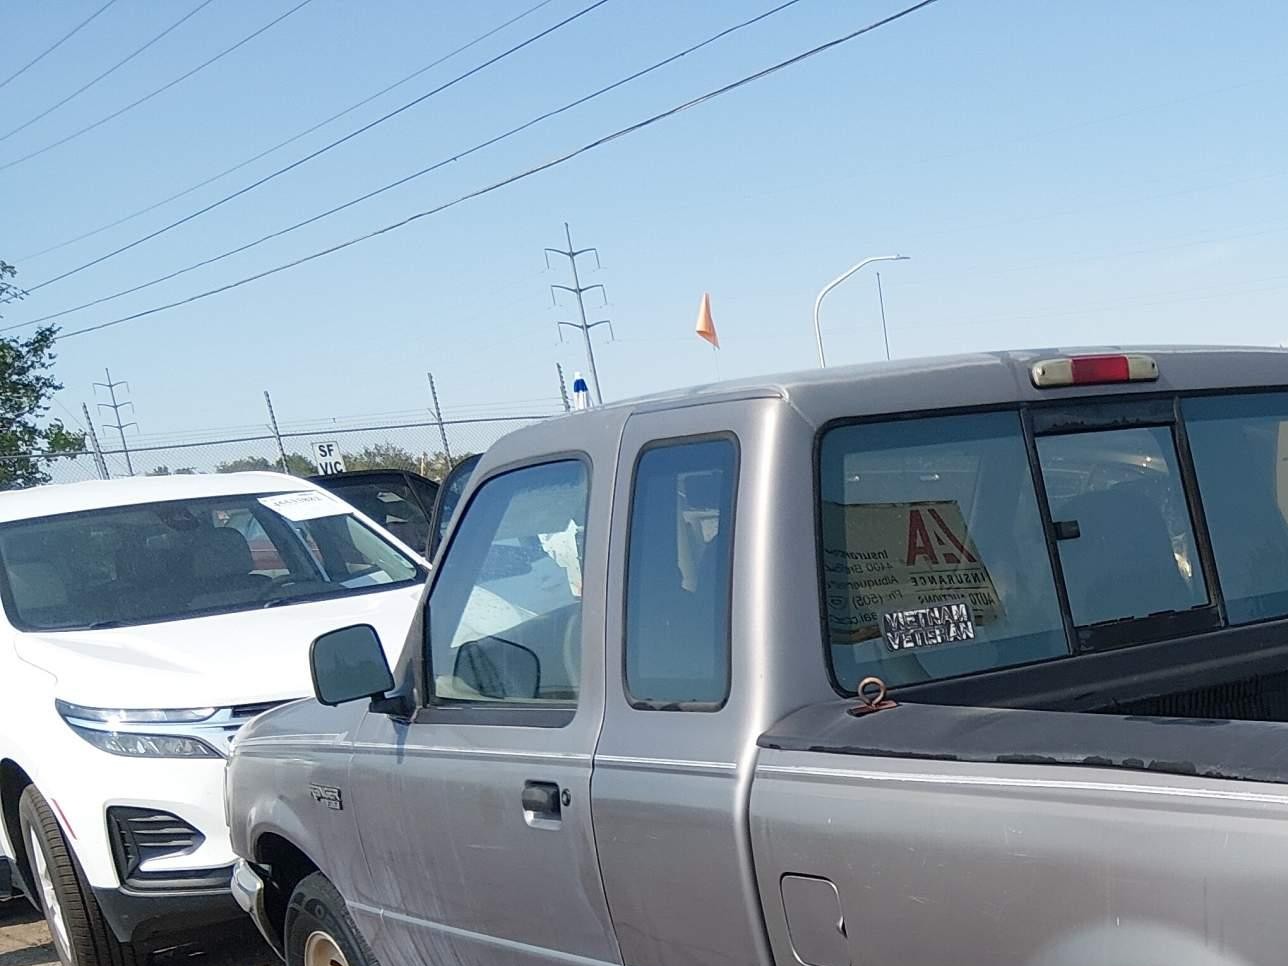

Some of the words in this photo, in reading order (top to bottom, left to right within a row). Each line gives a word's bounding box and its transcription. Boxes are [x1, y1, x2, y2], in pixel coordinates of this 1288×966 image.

[318, 444, 334, 458] SF
[319, 461, 344, 476] VIC
[884, 603, 967, 630] VIETNAM
[886, 621, 975, 650] VETERAN
